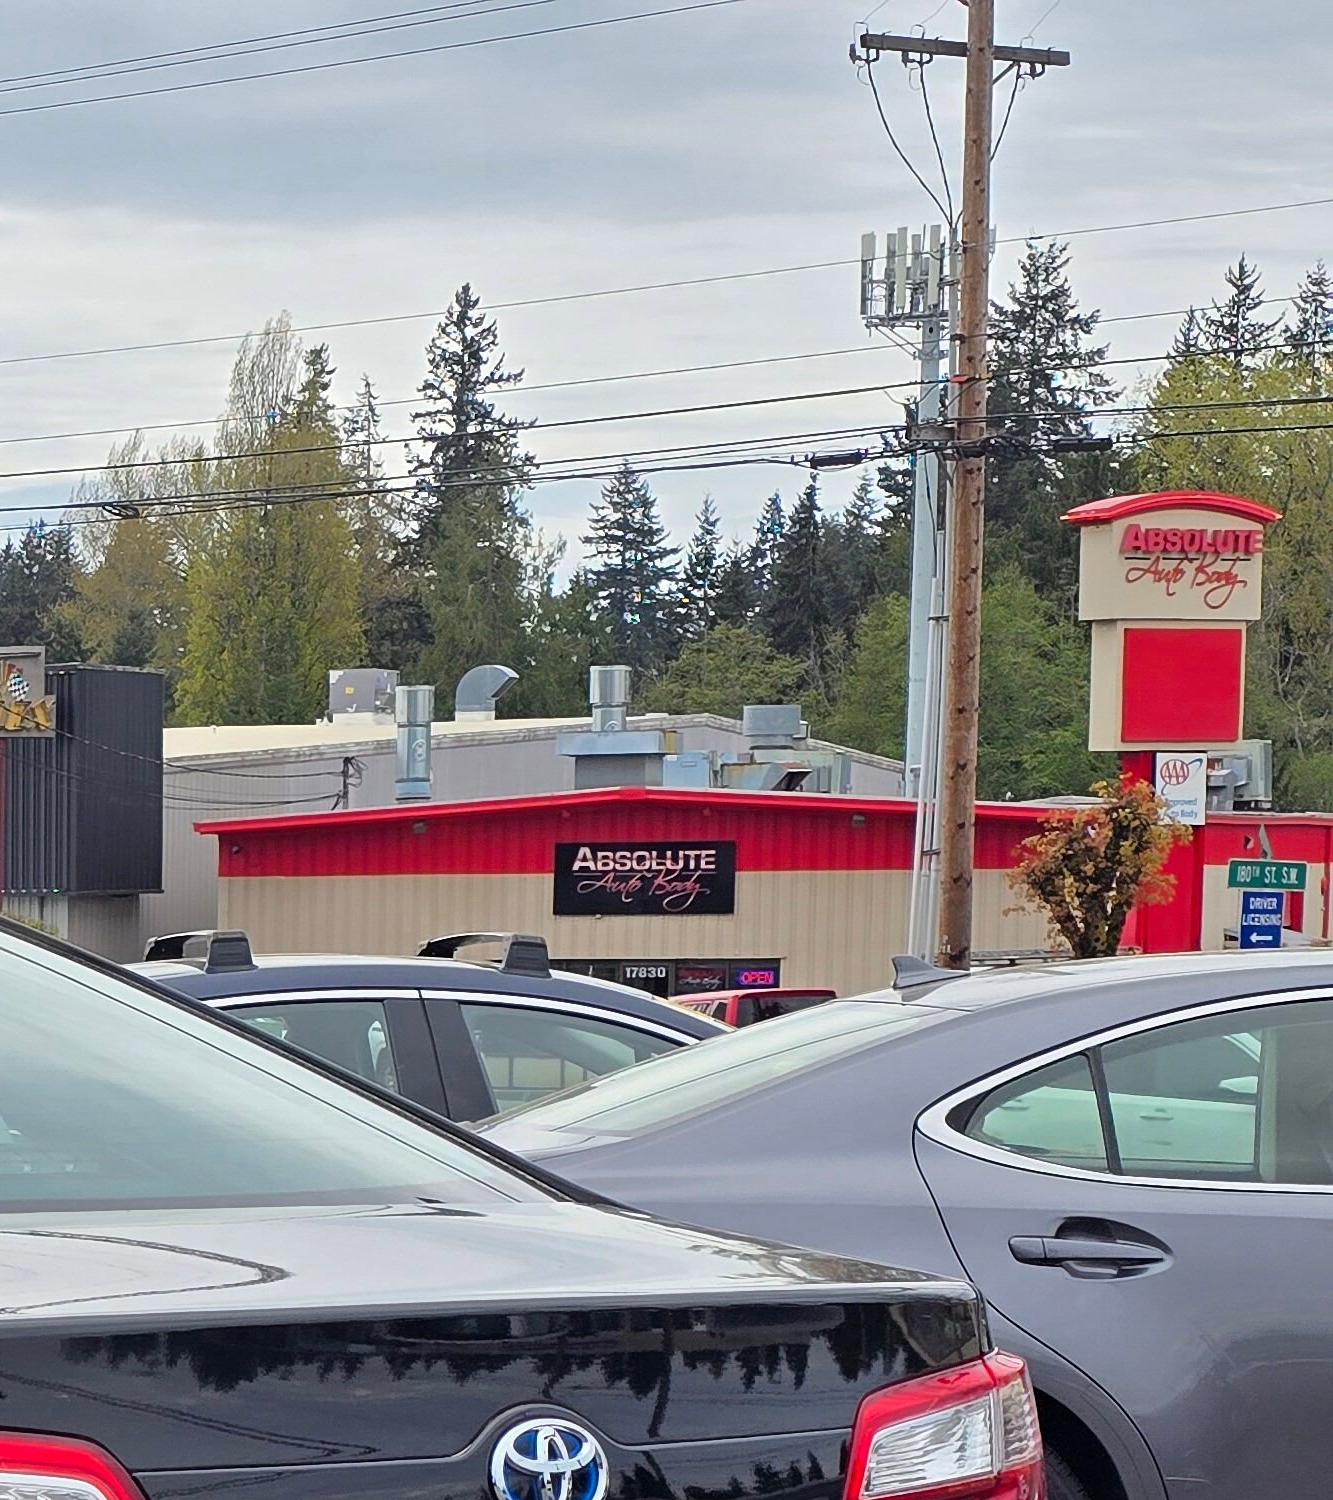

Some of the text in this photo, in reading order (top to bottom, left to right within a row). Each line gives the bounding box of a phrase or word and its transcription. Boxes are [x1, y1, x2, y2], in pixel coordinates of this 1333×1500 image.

[1119, 524, 1264, 554] ABSOLUTE
[1125, 552, 1247, 609] Auto Body
[1162, 760, 1188, 785] AAA
[572, 846, 717, 871] ABSOLUTE
[577, 867, 711, 912] Auto Body
[1249, 897, 1278, 910] DRIVER
[1242, 913, 1282, 926] LICENSING
[625, 966, 666, 978] 17830
[740, 970, 775, 985] OPEN
